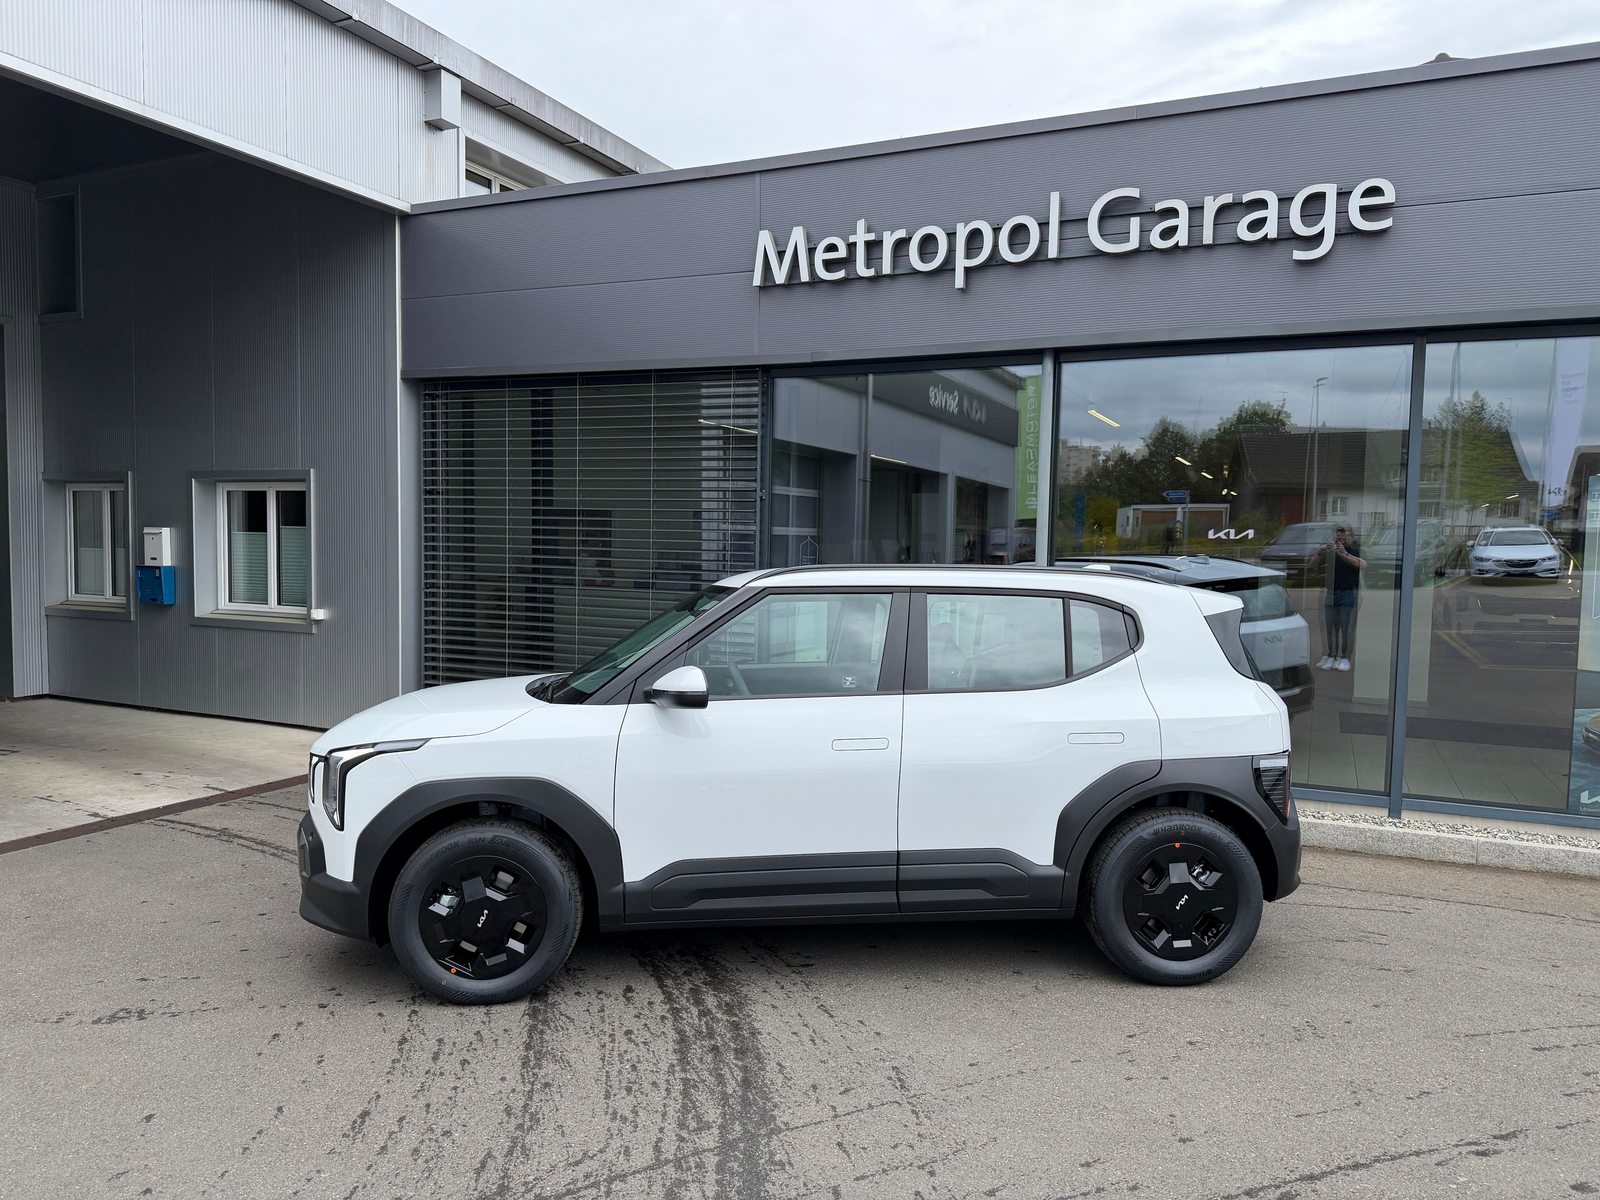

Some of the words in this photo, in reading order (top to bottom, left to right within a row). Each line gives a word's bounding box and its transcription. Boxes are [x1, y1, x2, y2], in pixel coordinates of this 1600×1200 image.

[753, 191, 1060, 289] Metropol
[1086, 177, 1396, 261] Garage
[1025, 386, 1038, 495] LEAPMOTOR
[1207, 528, 1255, 540] KIA
